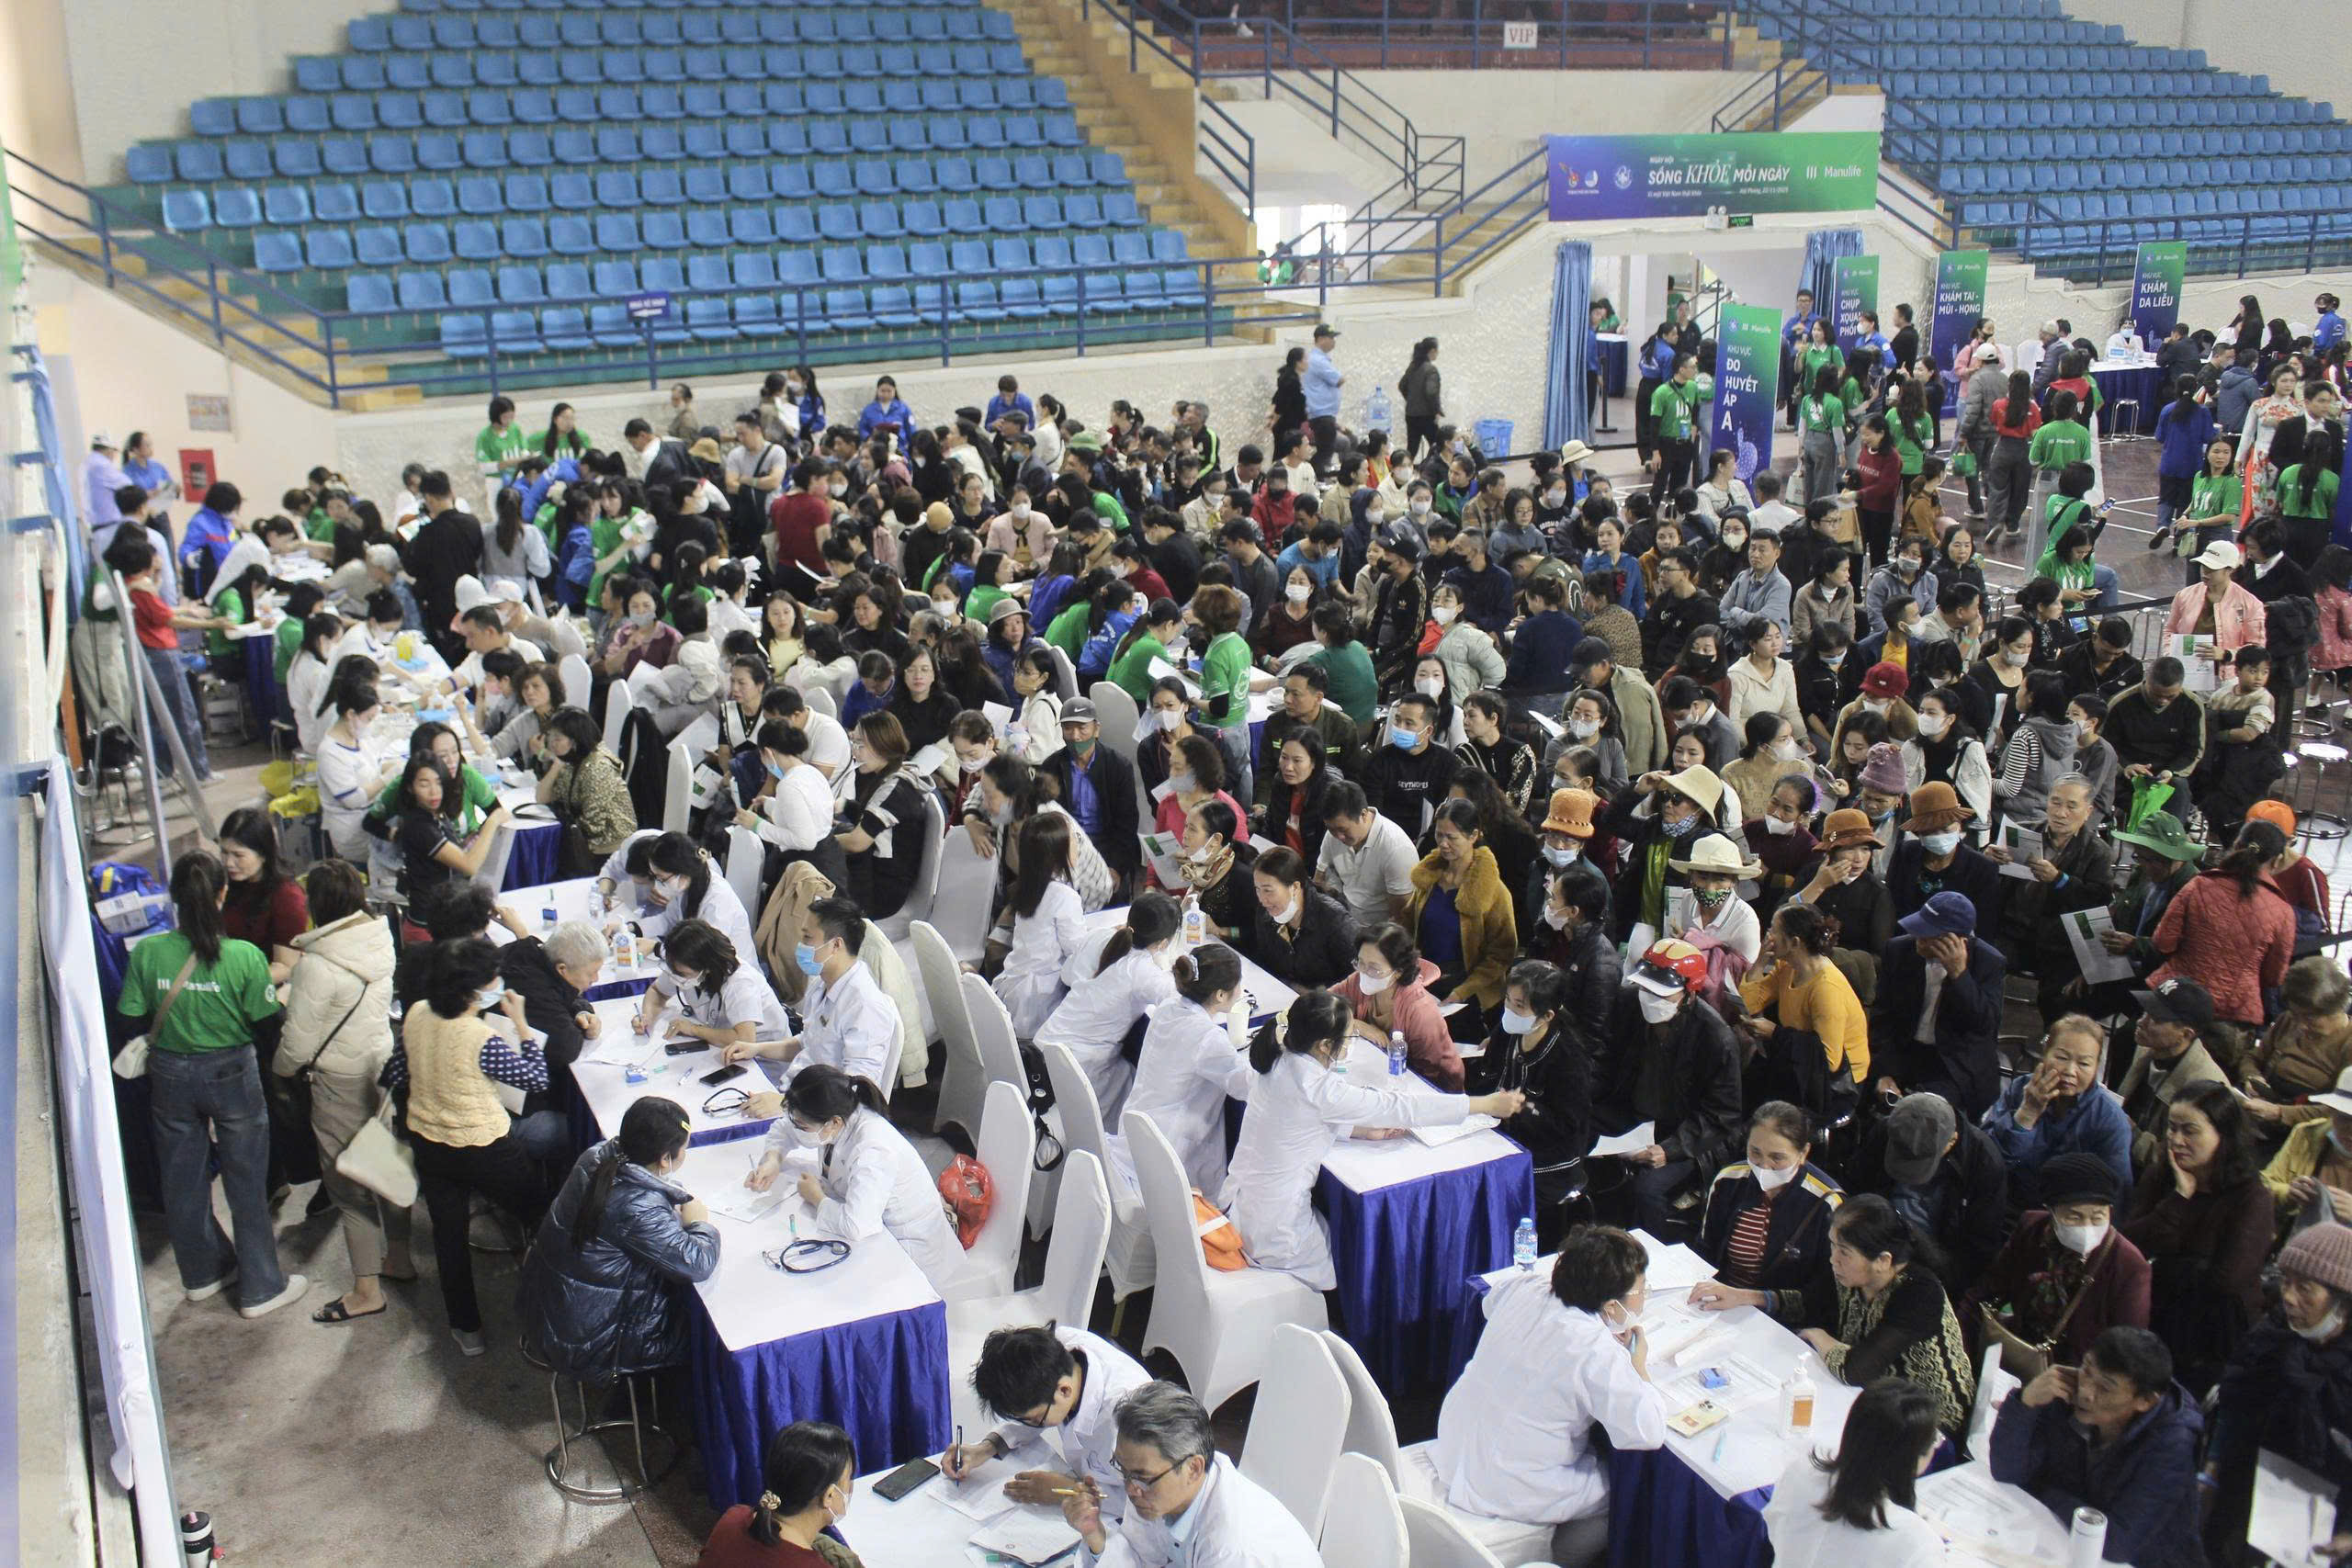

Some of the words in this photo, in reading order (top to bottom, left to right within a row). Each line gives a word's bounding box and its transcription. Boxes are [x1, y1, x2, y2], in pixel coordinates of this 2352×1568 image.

[1509, 28, 1534, 44] VIP
[1648, 165, 1682, 186] SỐNG
[1685, 159, 1732, 186] KHỎE
[1758, 164, 1791, 182] NGÀY
[1824, 164, 1861, 177] Manulife
[2140, 279, 2168, 294] KHÁM
[1939, 289, 1962, 302] KHÁM
[1963, 291, 1975, 301] TAI
[2138, 297, 2152, 309] DA
[2152, 292, 2173, 308] LIỄU
[1840, 298, 1860, 310] CHỤP
[1939, 302, 1954, 316] MŨI
[1959, 303, 1981, 316] HỌNG
[1727, 344, 1740, 355] KHU
[1740, 345, 1752, 356] VỰC
[1726, 358, 1741, 373] ĐO
[1724, 375, 1758, 393] HUYẾT
[1723, 390, 1737, 407] ÁP
[1721, 411, 1733, 432] A
[181, 979, 221, 993] anulife
